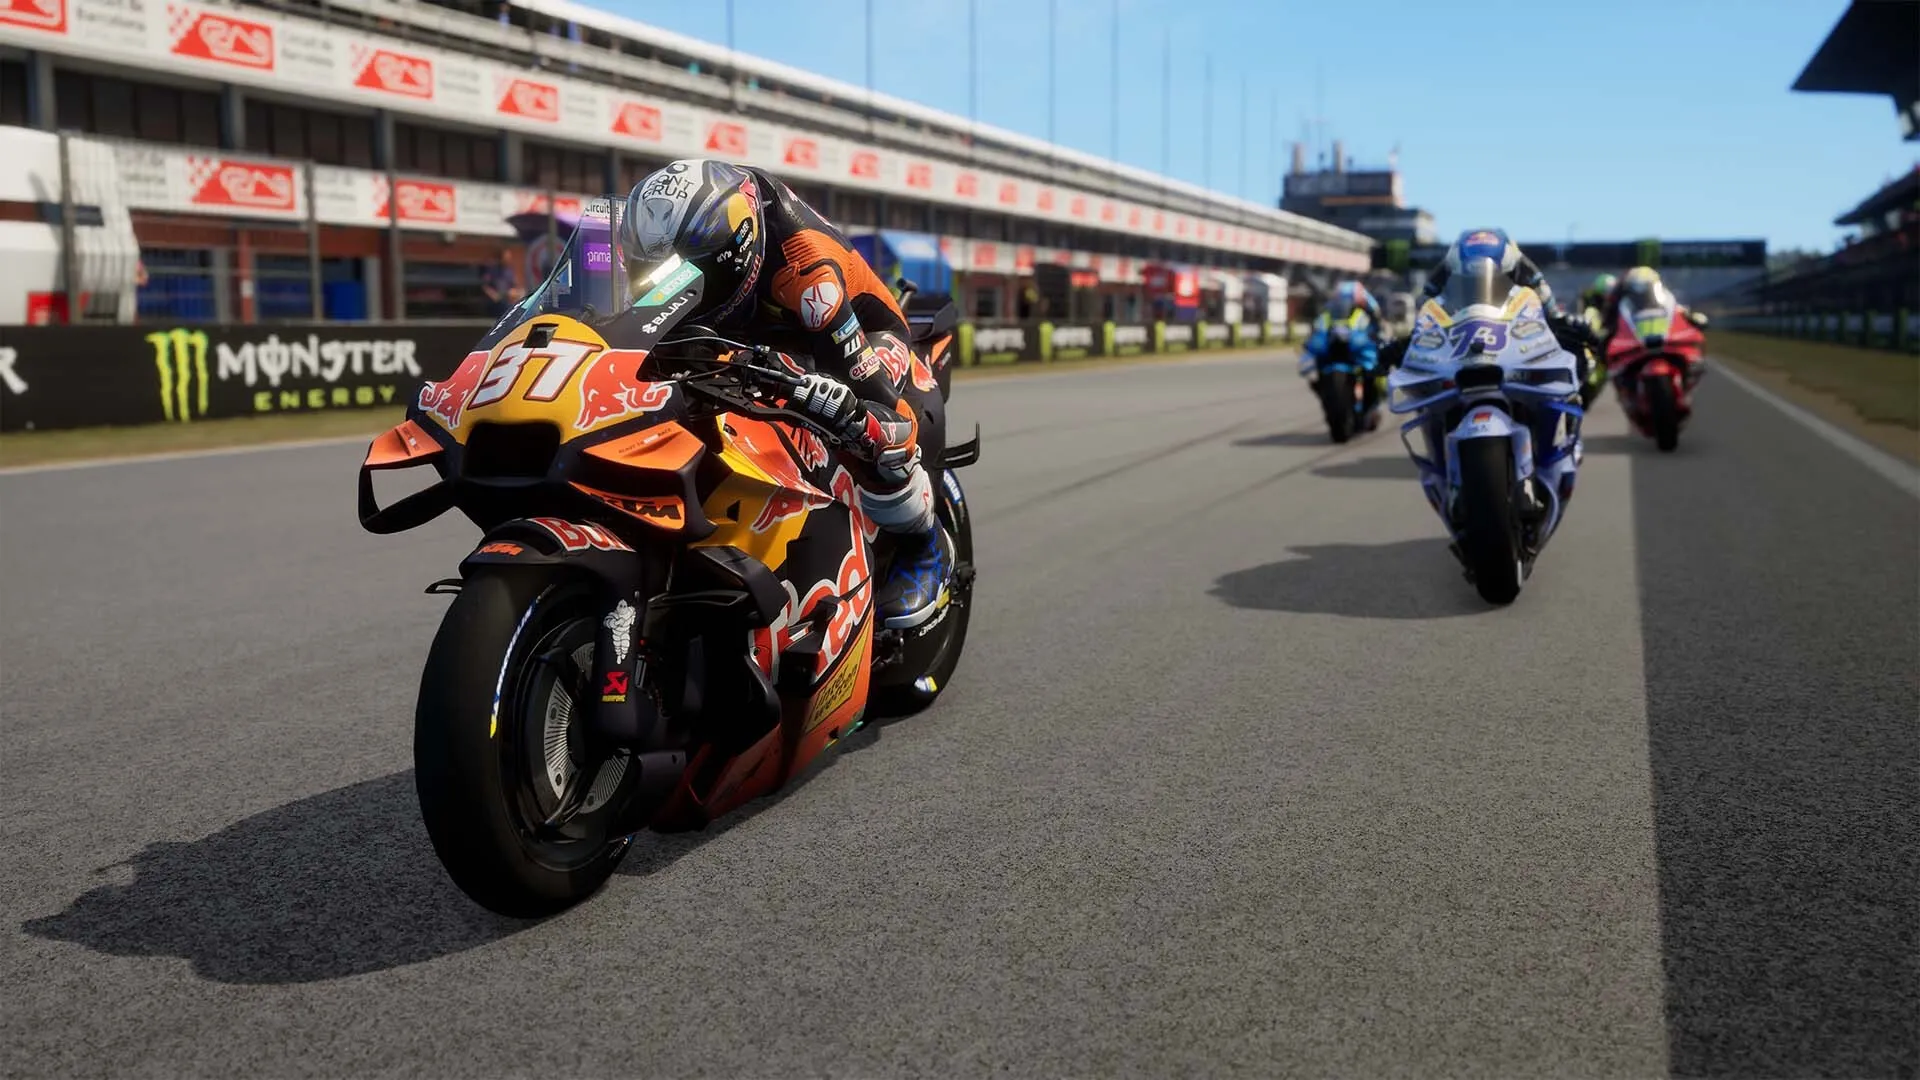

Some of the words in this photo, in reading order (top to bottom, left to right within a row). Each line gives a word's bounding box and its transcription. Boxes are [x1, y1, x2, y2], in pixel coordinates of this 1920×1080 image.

[642, 184, 688, 200] GRUP
[652, 296, 688, 326] BAJAJ
[216, 334, 422, 387] MONSTER
[467, 338, 604, 411] 37
[254, 385, 395, 411] ENERGY
